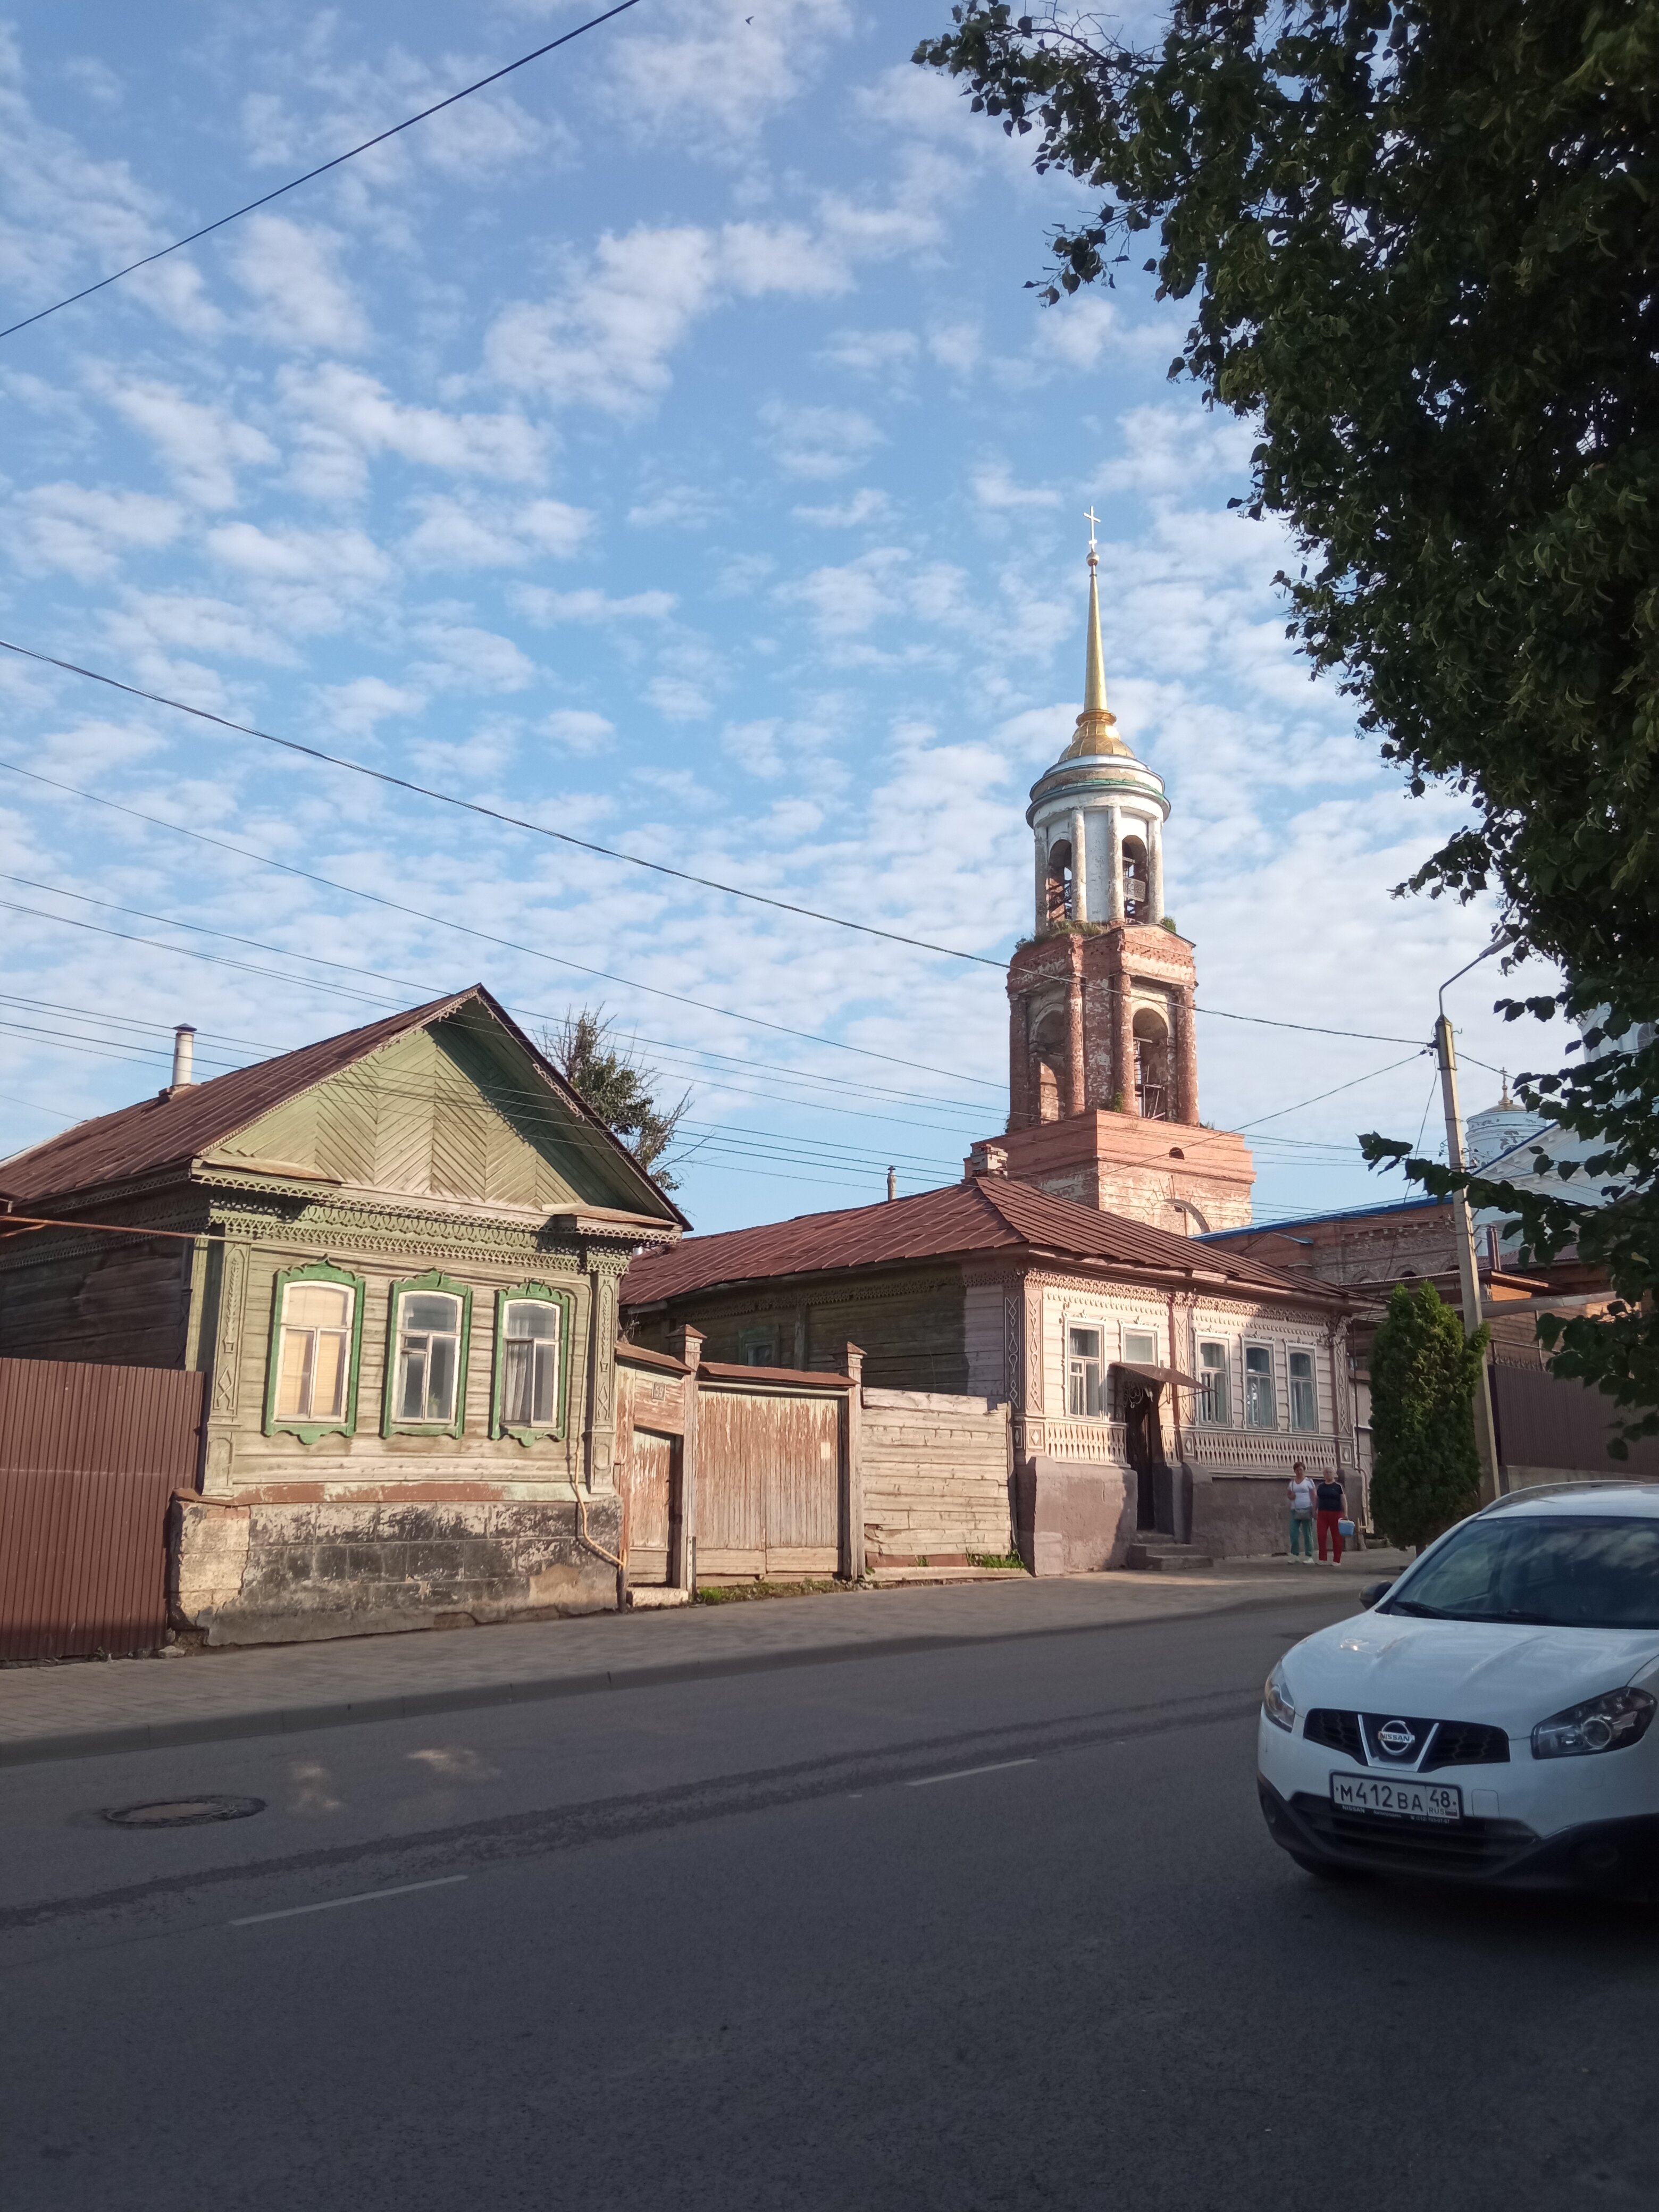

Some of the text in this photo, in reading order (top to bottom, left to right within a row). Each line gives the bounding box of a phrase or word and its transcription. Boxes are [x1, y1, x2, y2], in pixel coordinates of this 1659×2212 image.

[655, 1386, 663, 1397] 59
[1379, 1732, 1410, 1742] NISSAN
[1340, 1782, 1451, 1812] М412ВА 48
